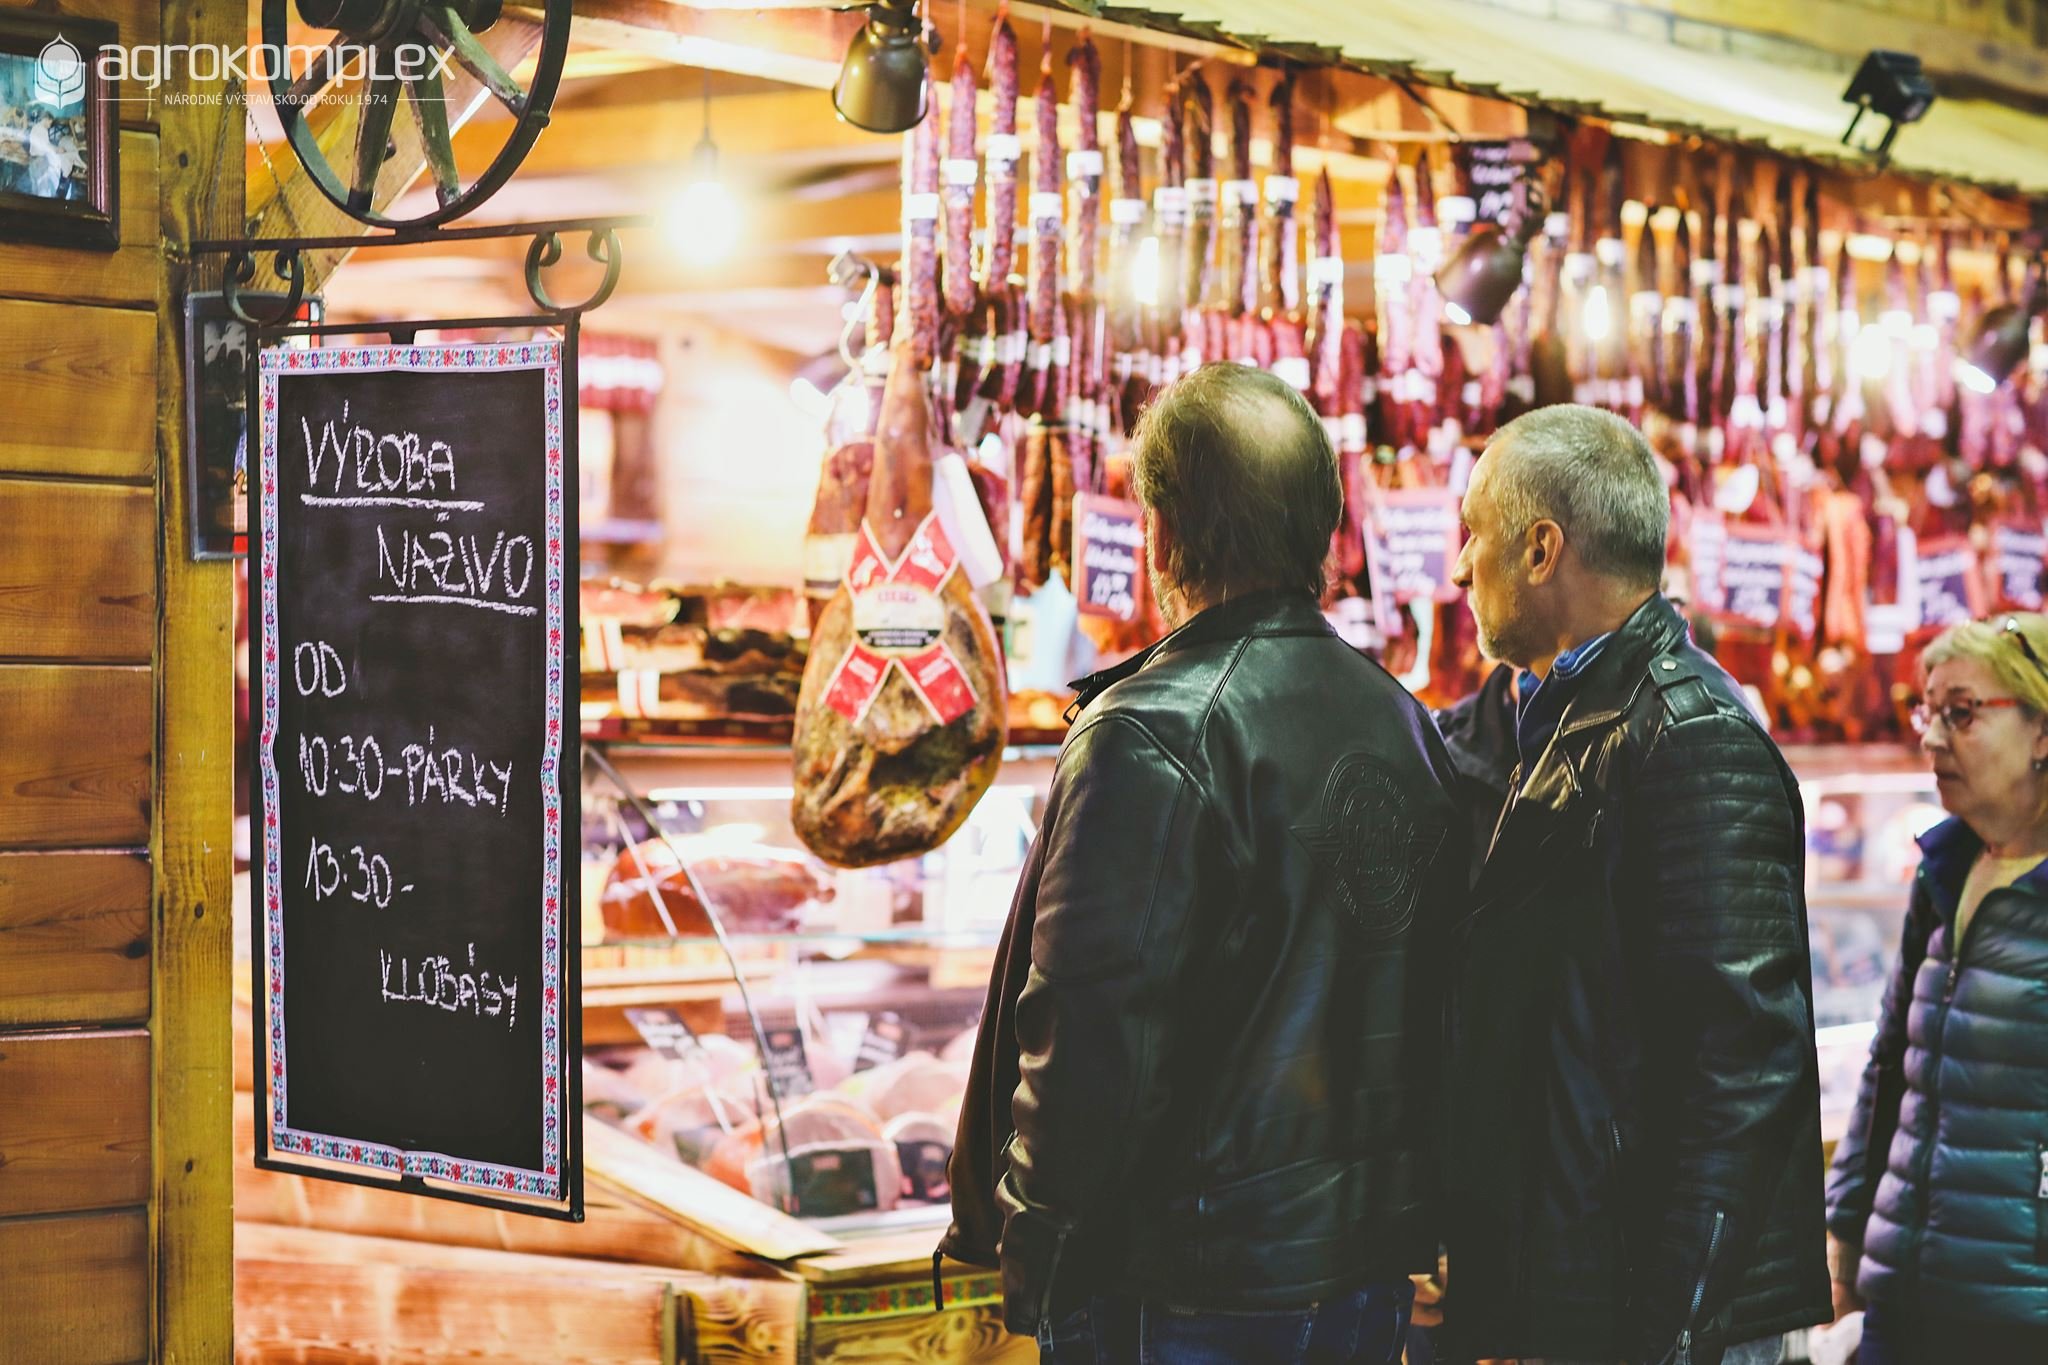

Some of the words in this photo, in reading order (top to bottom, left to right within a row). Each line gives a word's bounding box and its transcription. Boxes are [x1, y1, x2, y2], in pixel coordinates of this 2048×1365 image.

[301, 399, 457, 493] VÝROBA
[375, 511, 535, 600] NAŽIVO
[294, 640, 348, 699] OD
[380, 942, 519, 1034] KLOBÁSY
